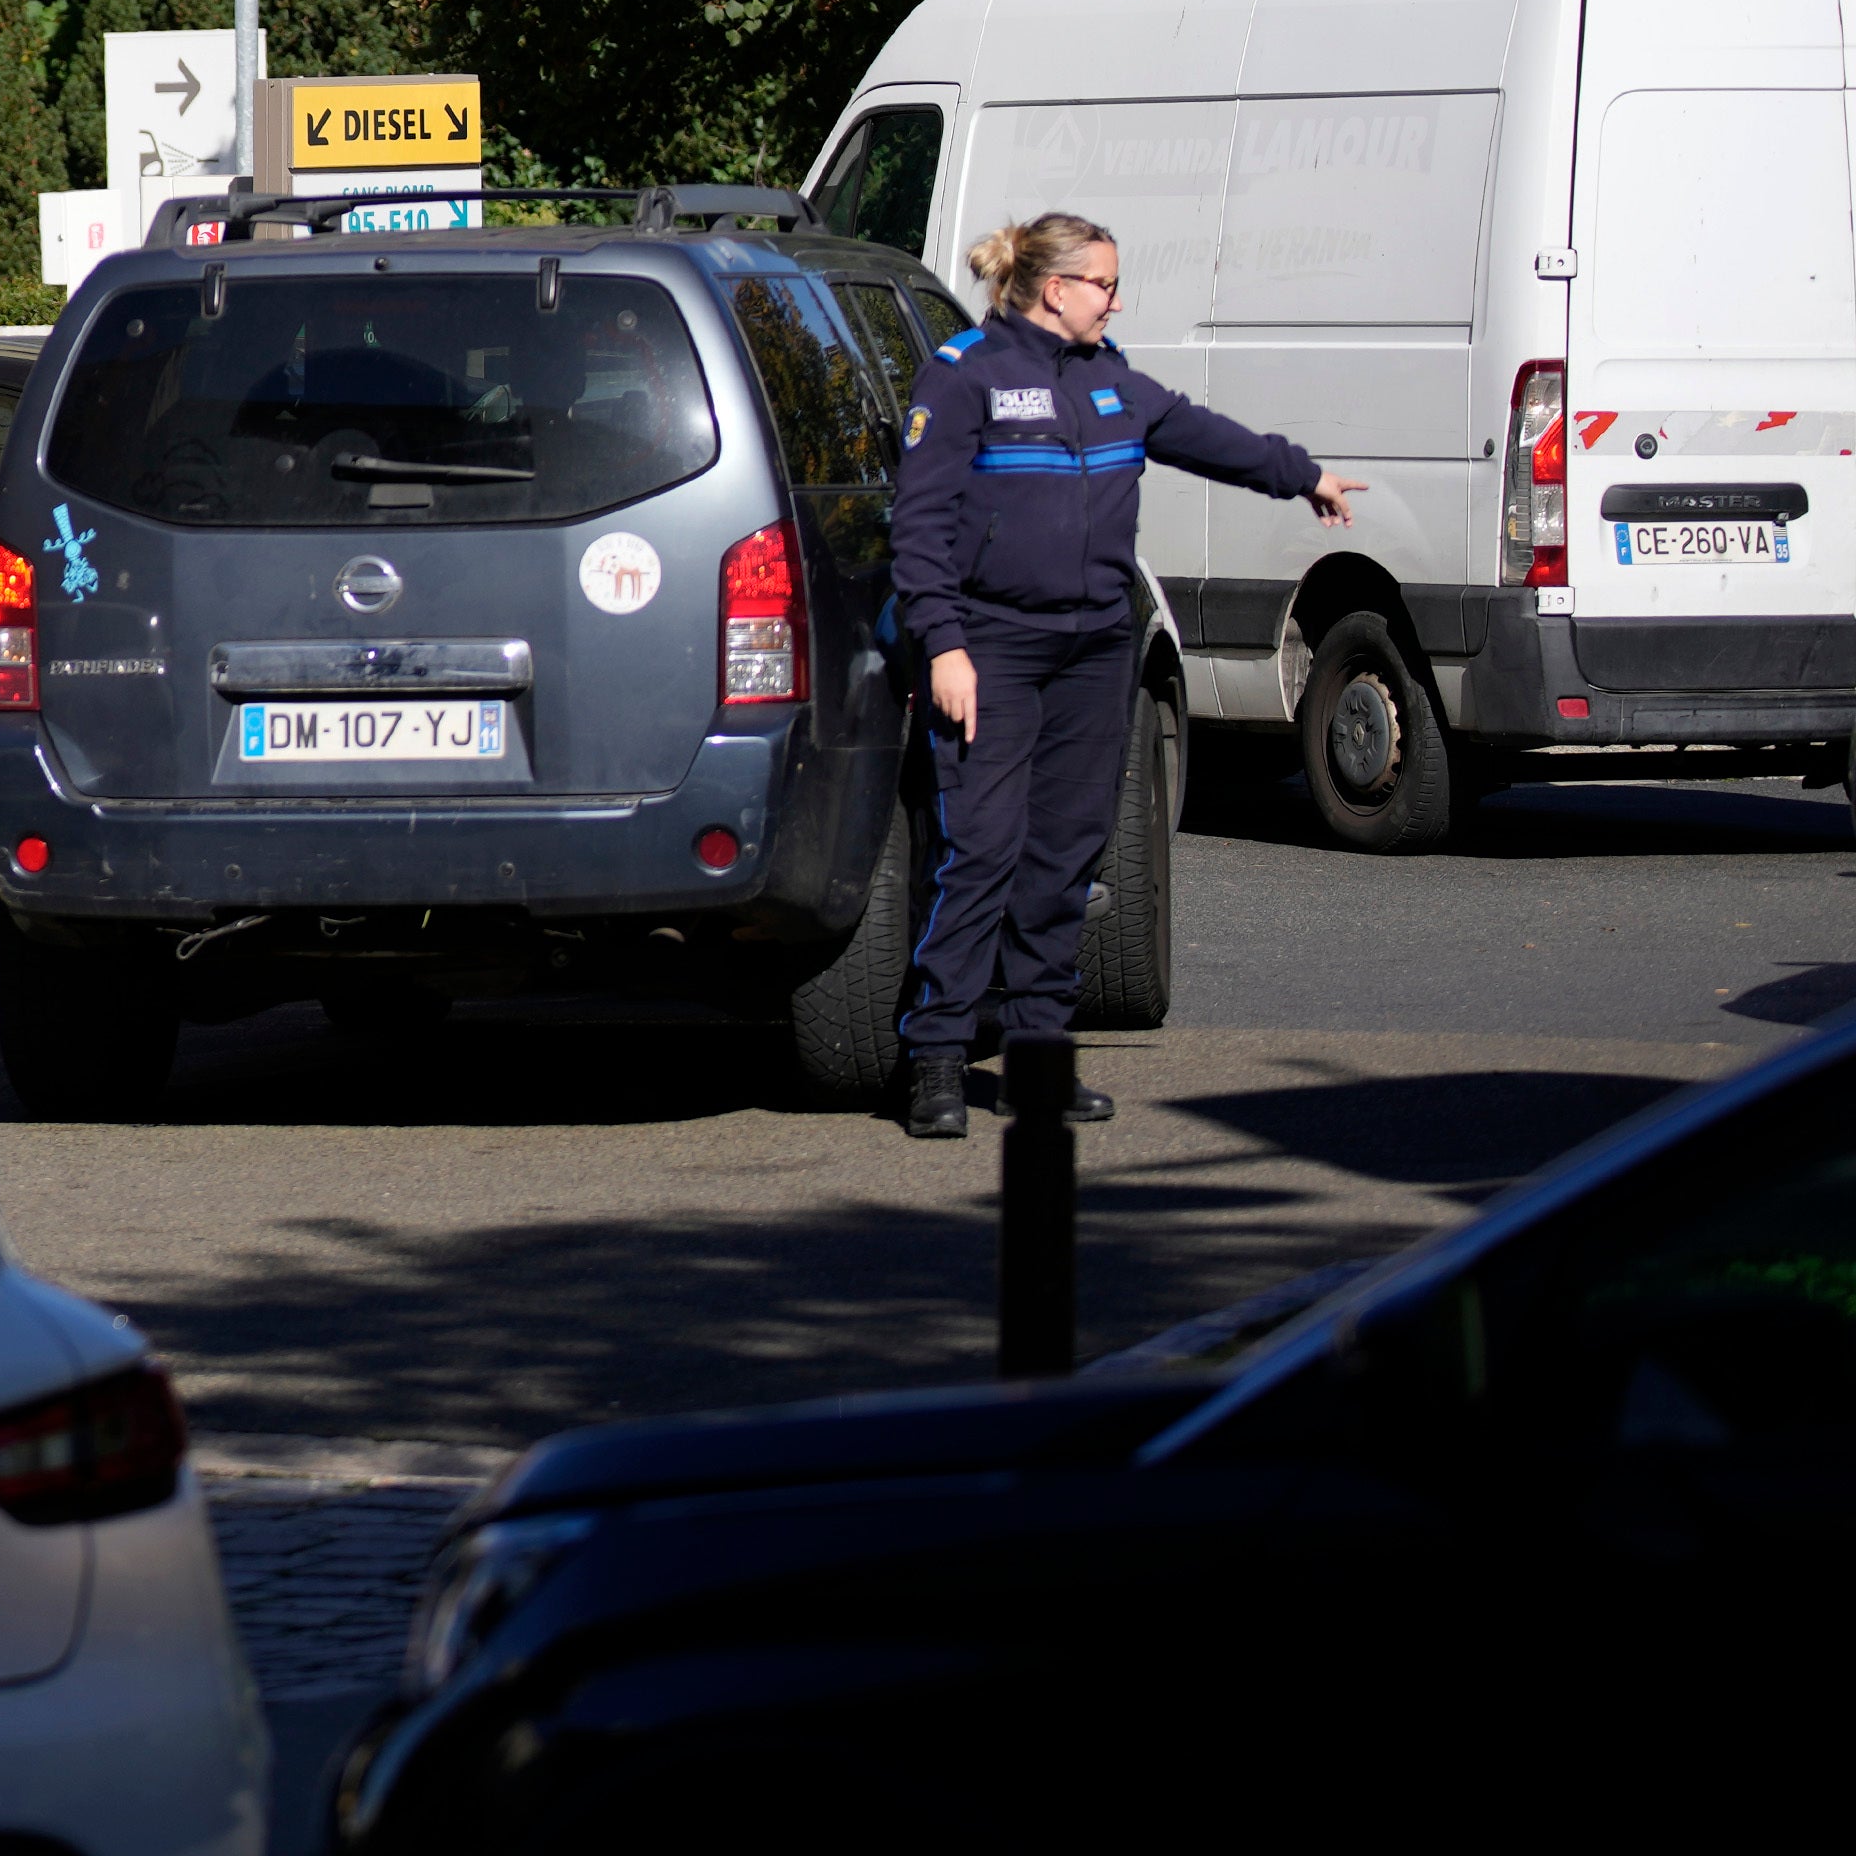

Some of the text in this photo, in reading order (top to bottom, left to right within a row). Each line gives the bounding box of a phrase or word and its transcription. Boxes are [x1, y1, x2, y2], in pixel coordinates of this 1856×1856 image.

[344, 109, 432, 141] DIESEL
[1238, 115, 1430, 175] LAMOUR
[1657, 494, 1761, 509] MASTER
[1637, 526, 1770, 555] CE-260-VA
[1776, 543, 1789, 559] 35
[49, 658, 165, 676] PATHFINDER
[269, 710, 474, 749] DM-107-YJ
[479, 728, 500, 753] 11
[249, 736, 260, 750] F
